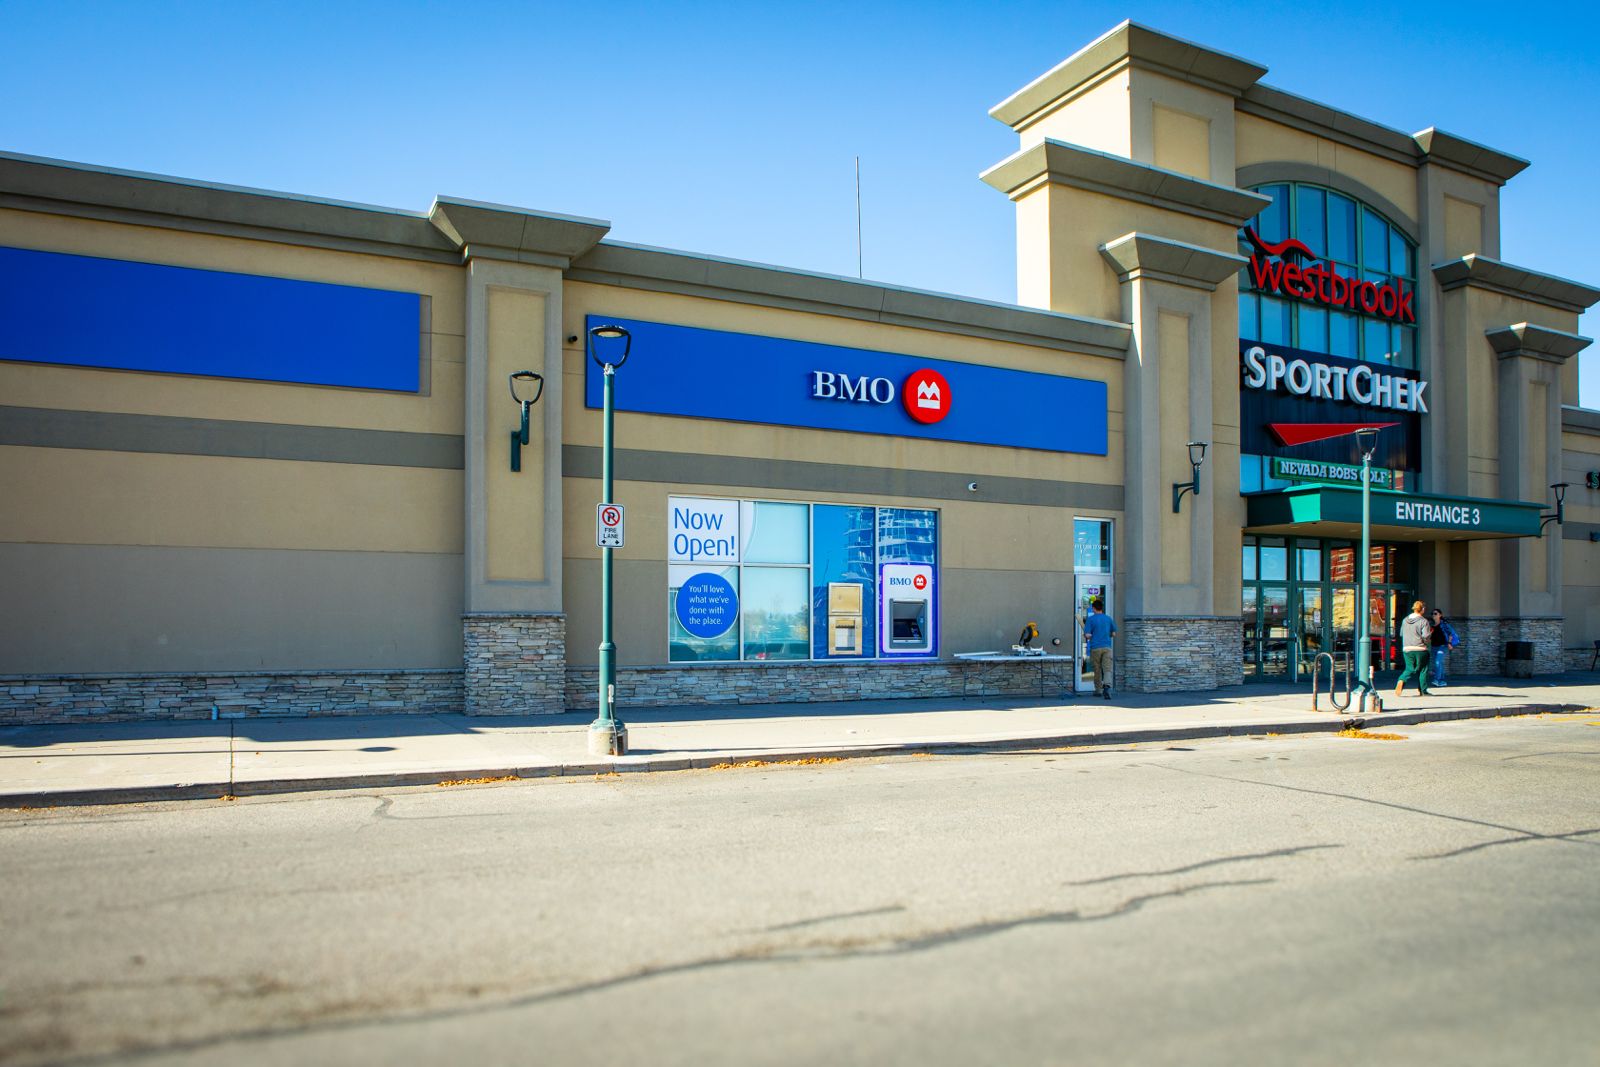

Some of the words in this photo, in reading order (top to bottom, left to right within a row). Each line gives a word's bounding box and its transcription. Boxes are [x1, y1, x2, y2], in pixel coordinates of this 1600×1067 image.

[1249, 254, 1415, 322] westbrook
[813, 371, 895, 404] BMO
[1244, 346, 1428, 413] SPORTCHEK
[1280, 461, 1327, 478] NEVADA
[1329, 466, 1358, 480] BOBS
[674, 507, 723, 530] Now
[1395, 501, 1470, 525] ENTRANCE
[1472, 508, 1480, 525] 3
[674, 533, 735, 561] Open!
[689, 584, 708, 593] You'll
[709, 584, 725, 594] love
[889, 577, 912, 586] BMO
[689, 595, 707, 604] what
[709, 596, 729, 604] we've
[689, 606, 707, 614] done
[708, 606, 725, 615] with
[689, 617, 701, 625] the
[702, 617, 723, 627] place.
